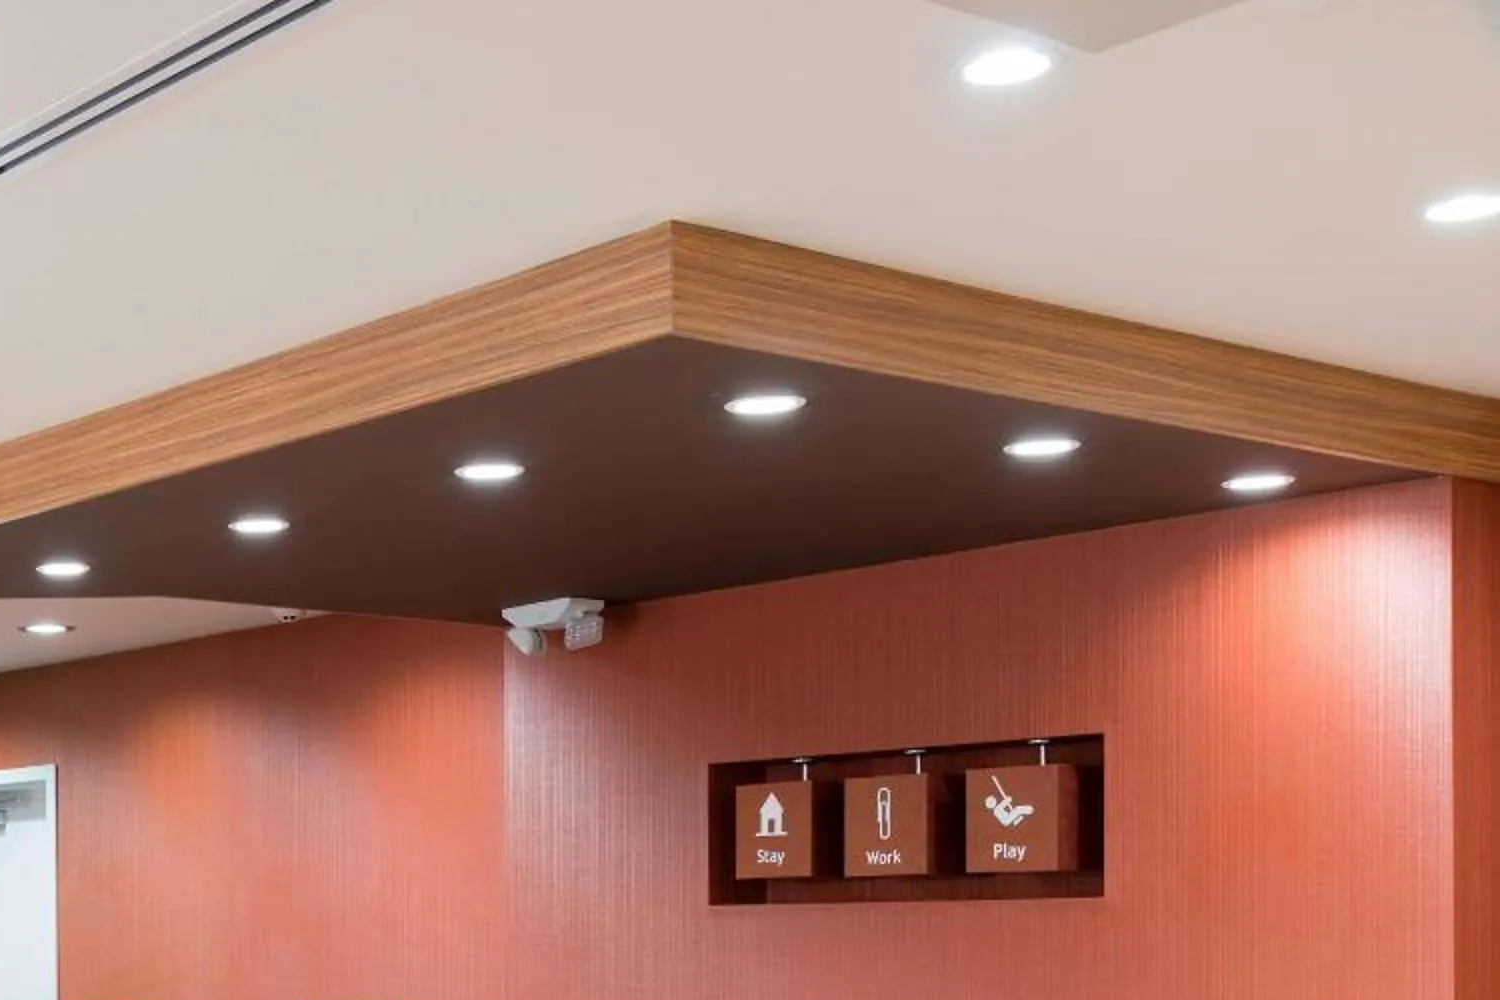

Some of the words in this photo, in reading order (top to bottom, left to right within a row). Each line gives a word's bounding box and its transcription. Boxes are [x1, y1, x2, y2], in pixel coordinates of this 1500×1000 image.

[756, 849, 786, 866] Stay
[866, 850, 902, 866] Work
[993, 843, 1026, 861] Play
